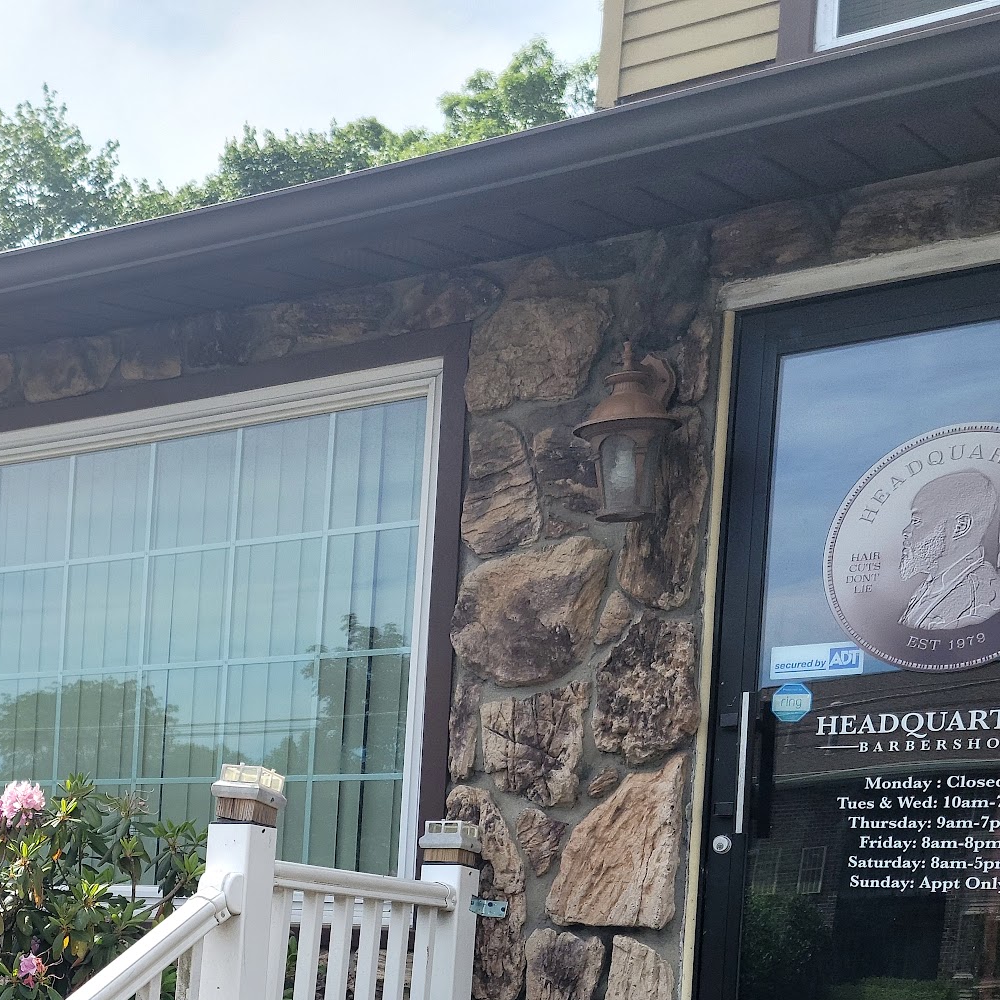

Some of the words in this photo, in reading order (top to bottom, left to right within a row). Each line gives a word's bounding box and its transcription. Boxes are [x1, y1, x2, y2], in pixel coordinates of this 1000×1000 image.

[851, 551, 881, 562] HAIR
[849, 562, 881, 573] CUTS
[854, 584, 873, 594] LIE
[906, 635, 941, 651] EST
[948, 632, 986, 651] 1979
[774, 659, 814, 670] secured
[814, 659, 827, 669] by
[829, 650, 860, 667] ADT
[780, 696, 802, 710] ring
[858, 737, 1000, 753] BARBERSHO
[864, 776, 932, 792] Monday
[837, 796, 875, 810] Tues
[879, 796, 893, 809] &
[897, 795, 938, 809] Wed:
[848, 816, 932, 832] Thursday:
[859, 835, 917, 853] Friday:
[848, 855, 926, 873] Saturday:
[849, 874, 915, 892] Sunday:
[919, 876, 960, 893] Appt
